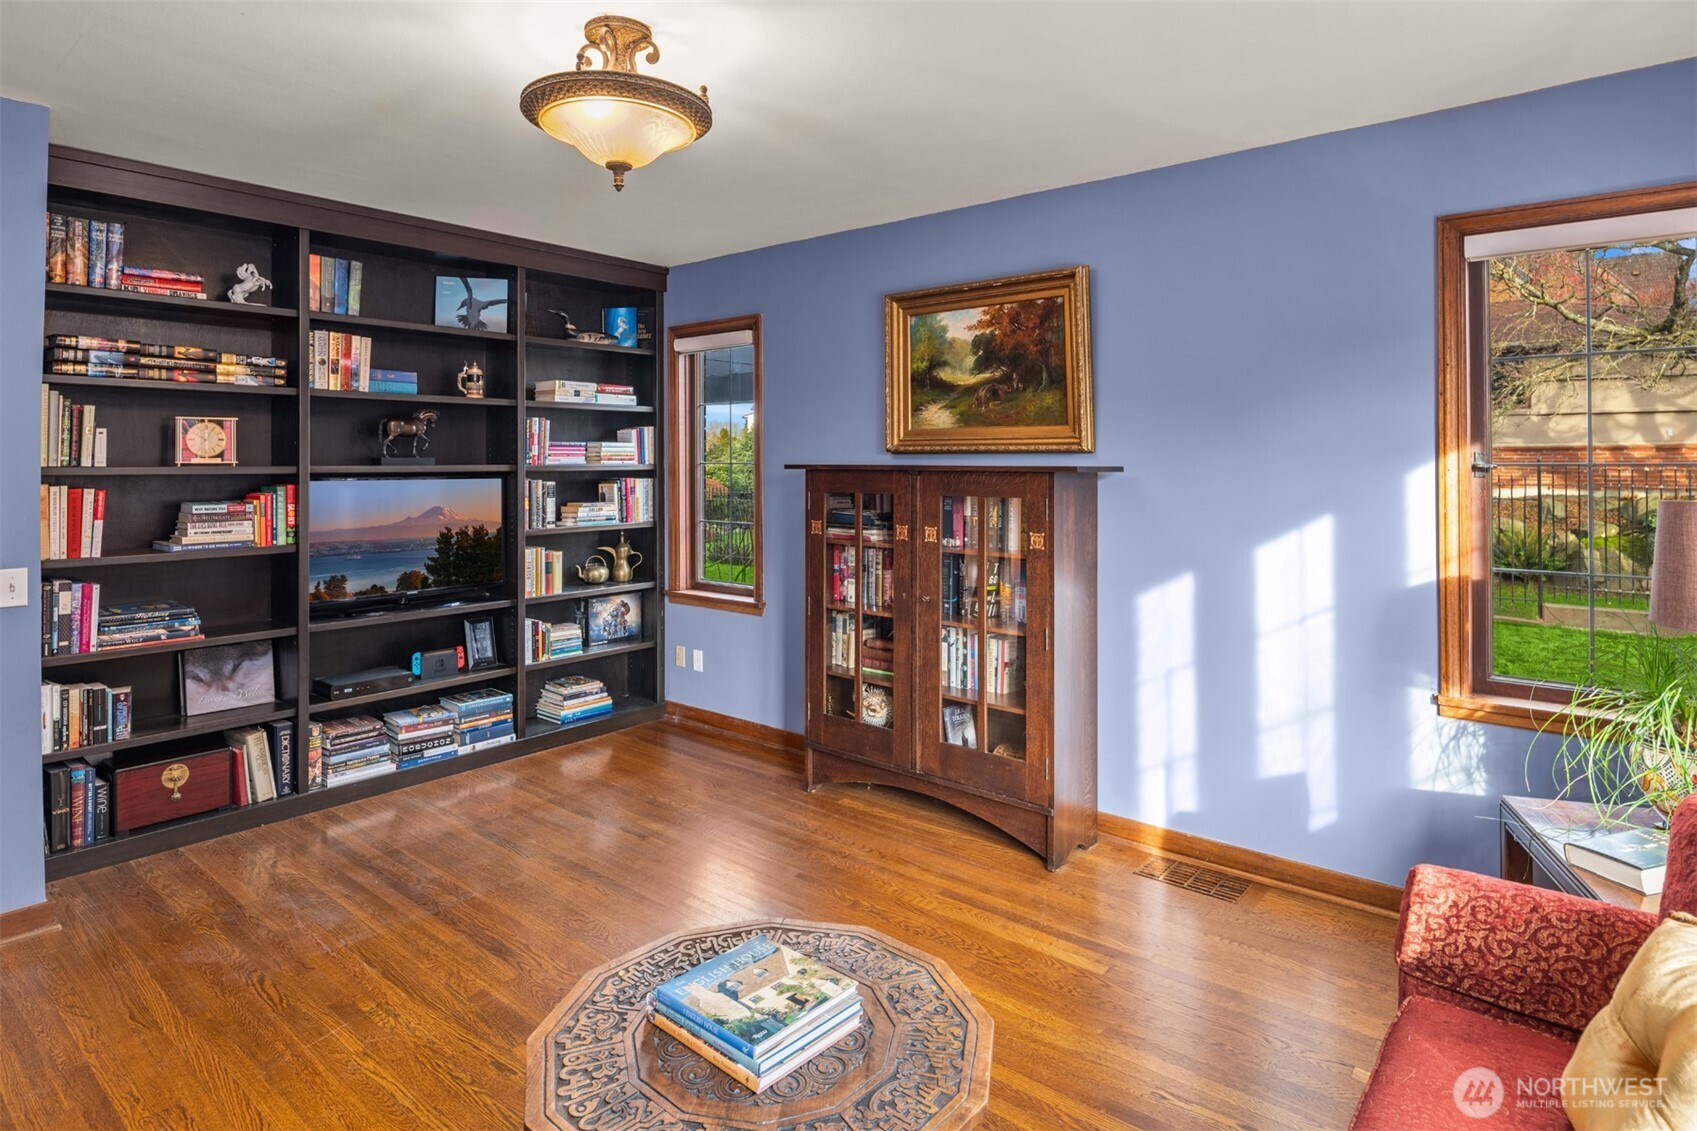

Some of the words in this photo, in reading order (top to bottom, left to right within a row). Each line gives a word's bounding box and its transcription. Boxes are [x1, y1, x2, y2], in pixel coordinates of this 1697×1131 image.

[287, 503, 295, 525] GLORY
[281, 735, 291, 784] DICTIONARY
[402, 737, 452, 753] ROBUCHON
[675, 957, 738, 997] ENGLISH
[727, 941, 777, 970] HOUSE
